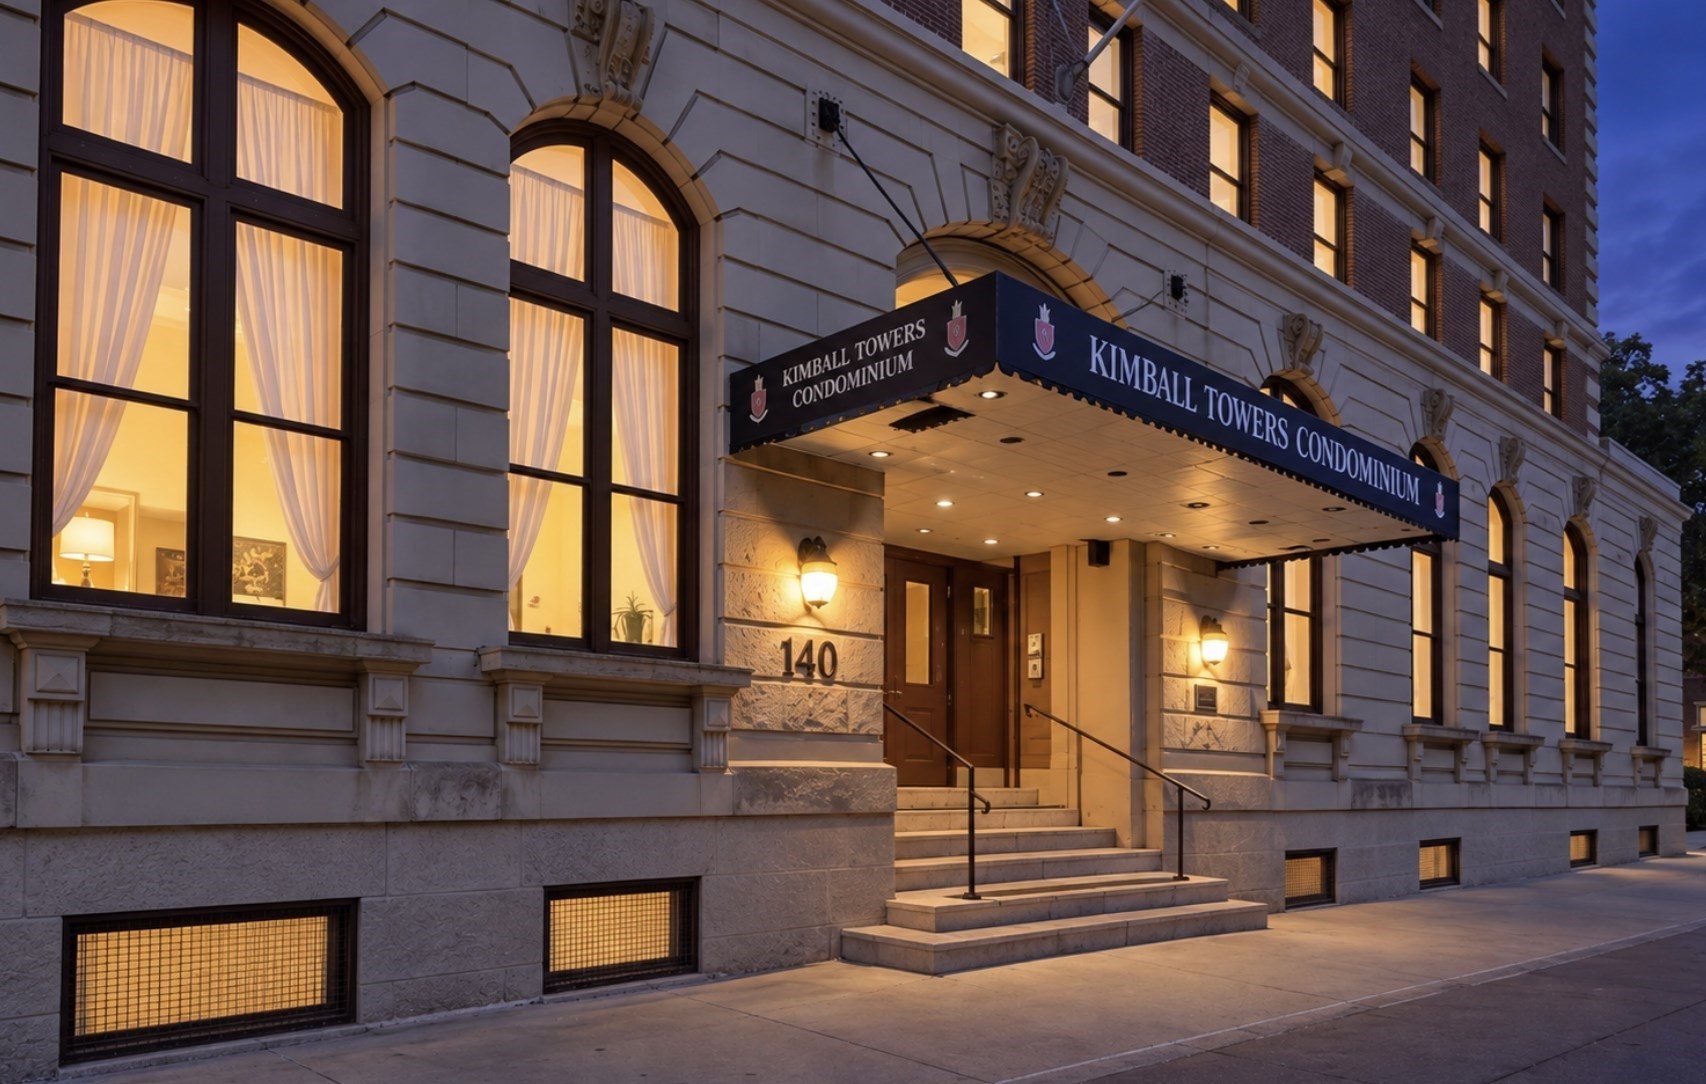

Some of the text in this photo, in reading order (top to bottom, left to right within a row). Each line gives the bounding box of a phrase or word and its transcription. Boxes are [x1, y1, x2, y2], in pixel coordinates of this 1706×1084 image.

[782, 318, 926, 387] KIMBALL TOWERS
[792, 350, 914, 408] CONDOMINIUM
[1088, 334, 1420, 506] KIMBALL TOWERS CONDOMINIUM
[780, 636, 838, 681] 140
